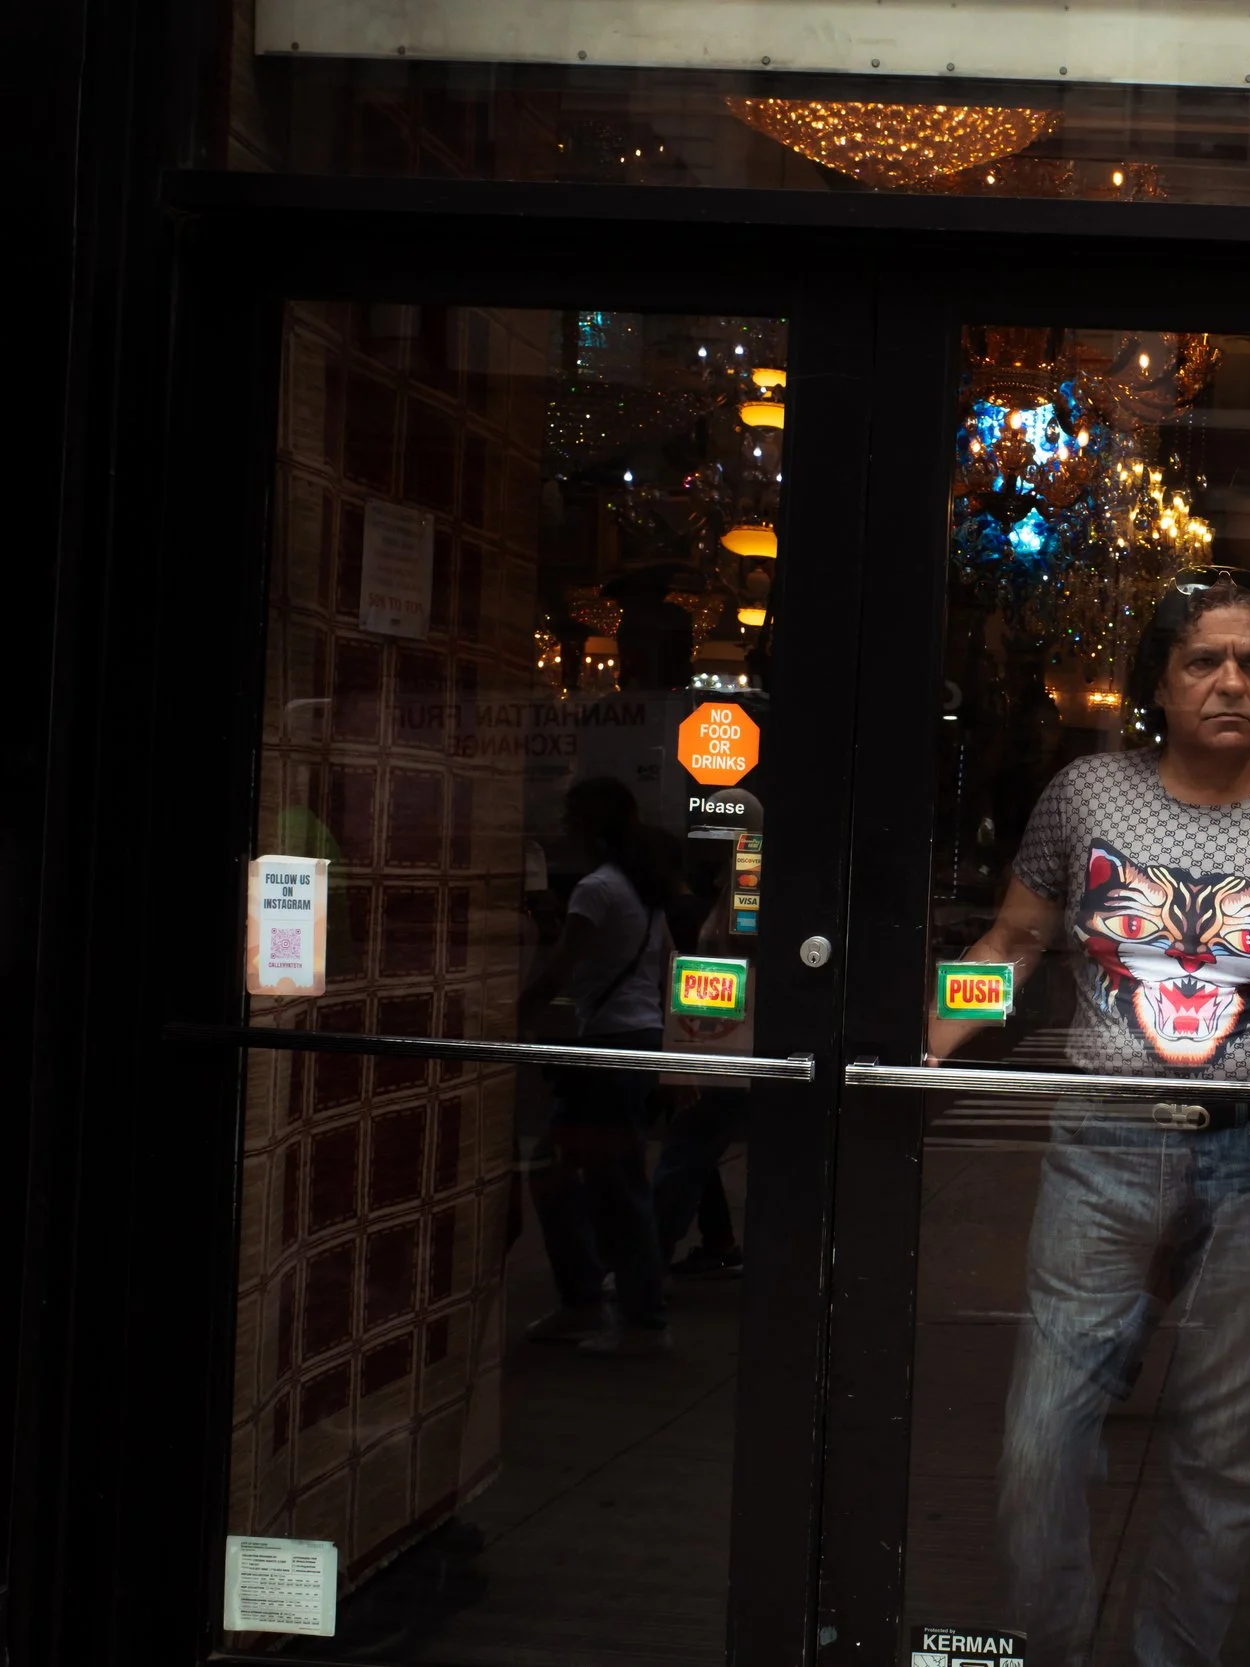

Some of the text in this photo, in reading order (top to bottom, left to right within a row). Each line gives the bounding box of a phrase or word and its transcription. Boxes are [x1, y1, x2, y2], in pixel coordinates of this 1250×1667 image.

[711, 709, 732, 723] NO
[700, 724, 741, 740] FOOD
[709, 740, 730, 754] OR
[691, 754, 746, 771] DRINKS
[689, 796, 745, 815] Please
[265, 873, 311, 885] FOLLOW US
[282, 886, 293, 897] ON
[263, 899, 311, 910] INSTAGRAM
[738, 896, 758, 906] VISA
[684, 974, 733, 1002] PUSH
[949, 979, 1000, 1004] PUSH
[922, 1633, 1013, 1655] KERMAN
